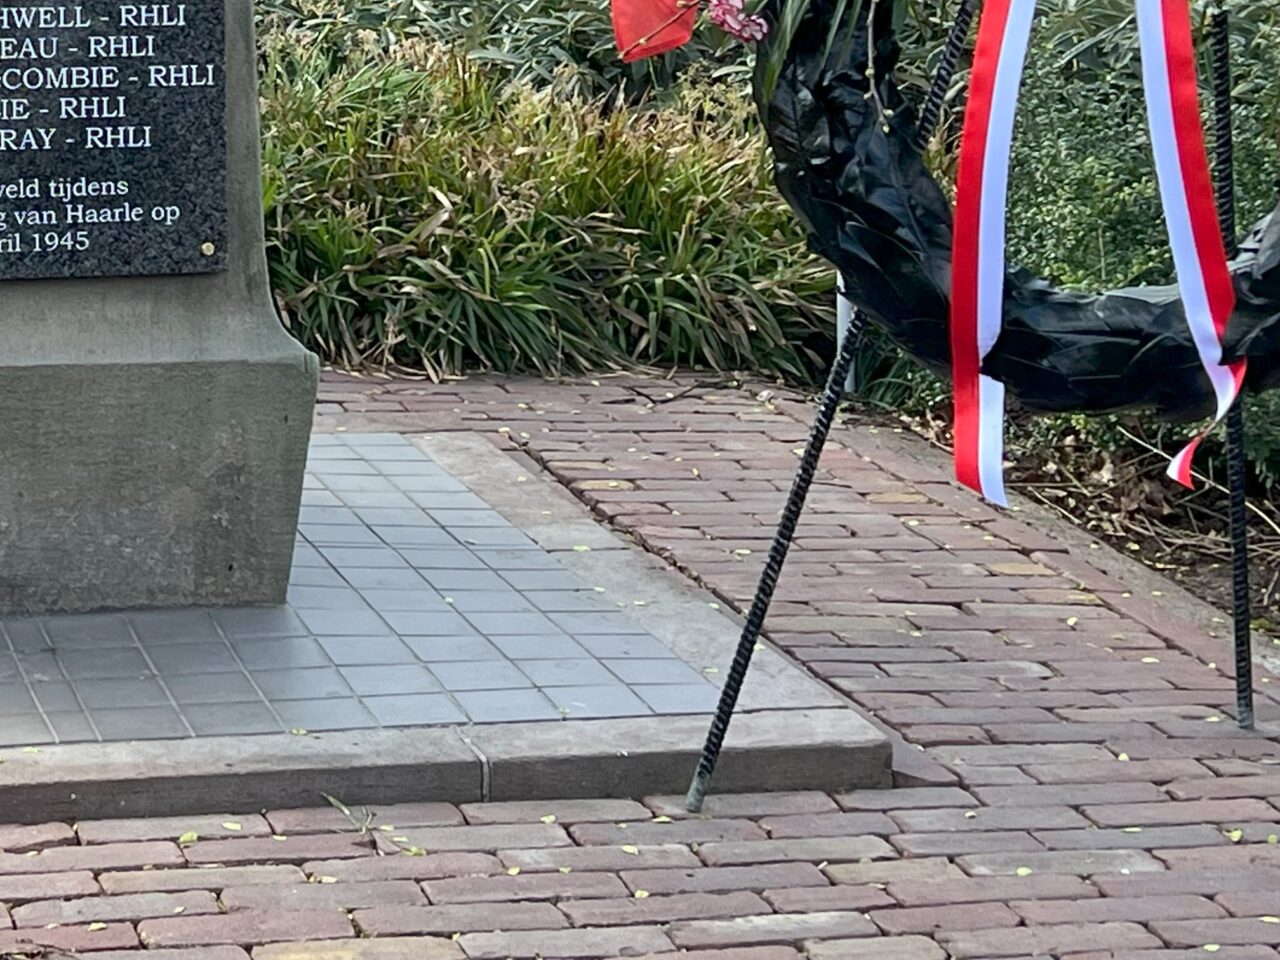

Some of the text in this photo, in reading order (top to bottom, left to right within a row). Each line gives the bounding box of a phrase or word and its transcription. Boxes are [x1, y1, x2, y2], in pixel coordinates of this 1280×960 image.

[119, 4, 186, 27] RHLI
[88, 35, 155, 58] RHLI
[148, 64, 214, 87] RHLI
[59, 96, 126, 119] RHLI
[85, 126, 152, 149] RHLI
[48, 176, 129, 202] tijdens
[13, 210, 58, 225] van
[65, 202, 144, 224] Haarle
[151, 205, 180, 226] op
[32, 231, 90, 252] 1945
